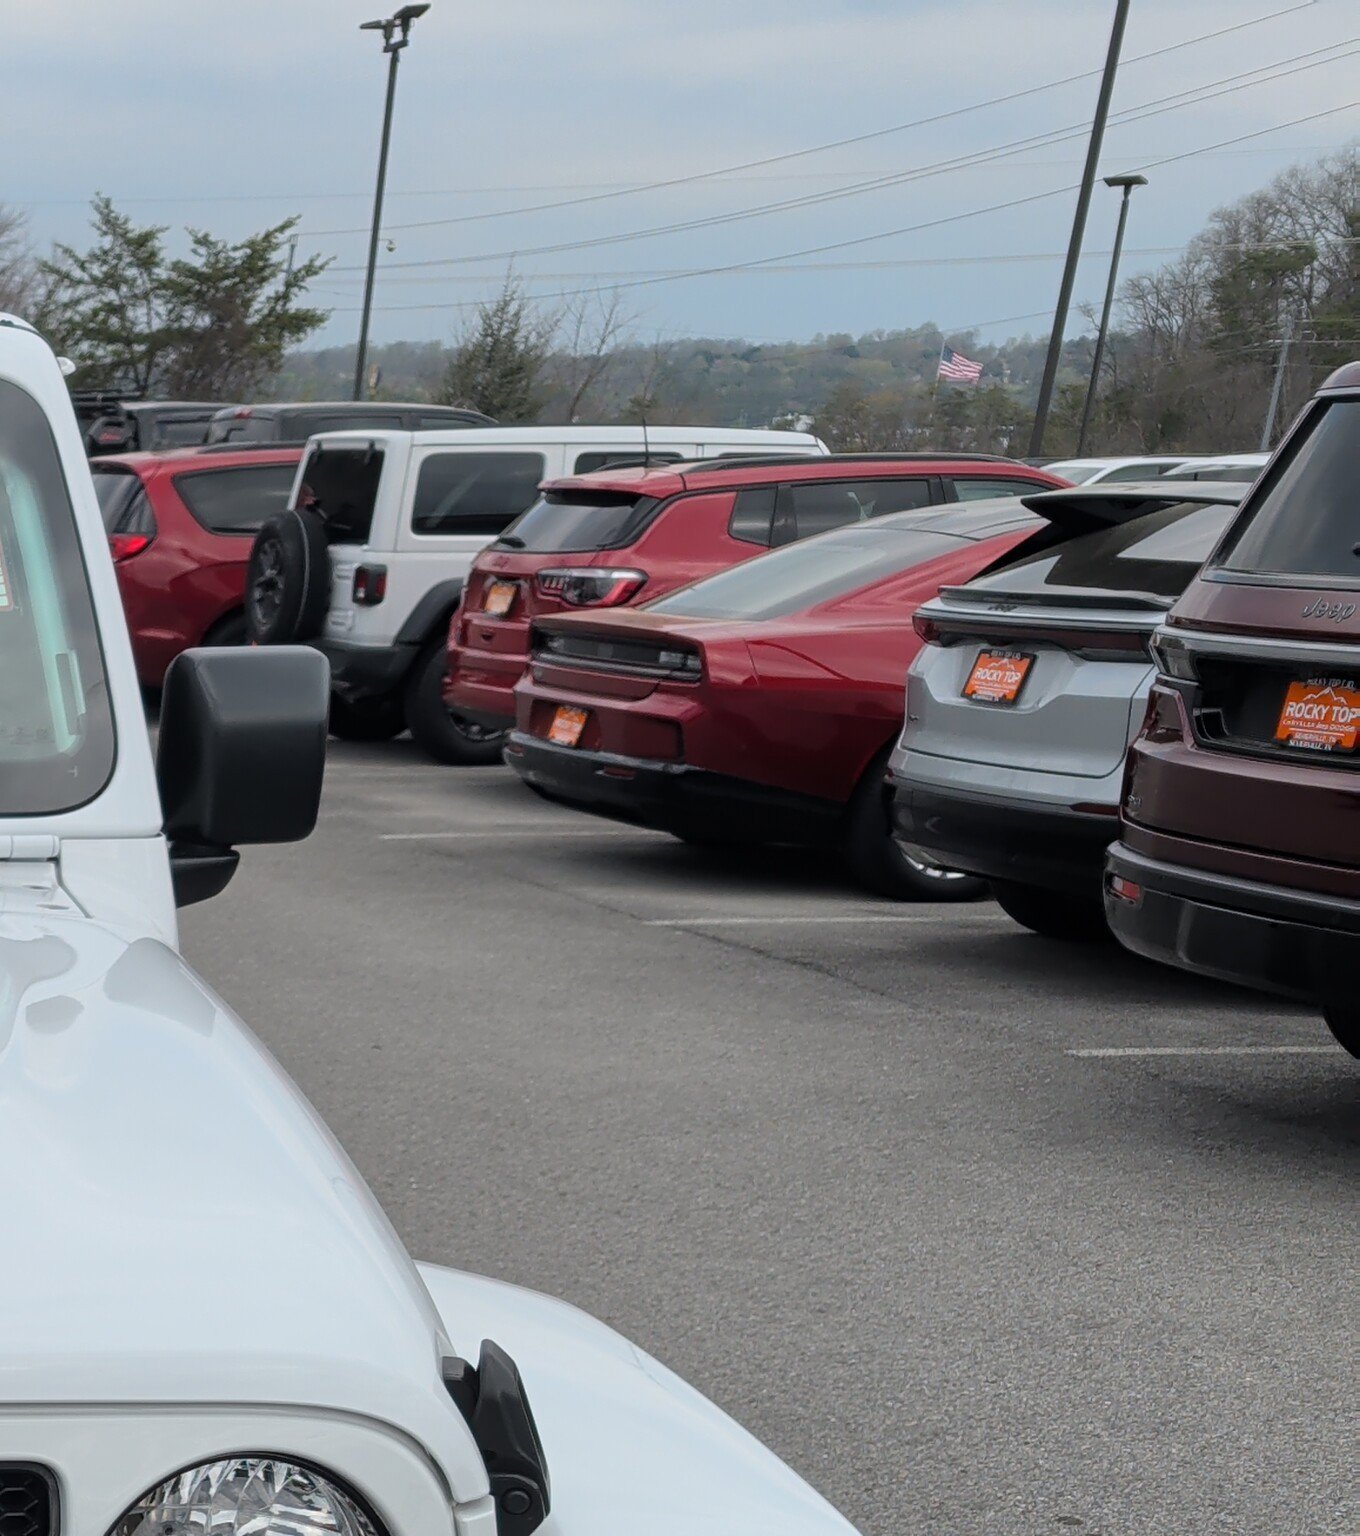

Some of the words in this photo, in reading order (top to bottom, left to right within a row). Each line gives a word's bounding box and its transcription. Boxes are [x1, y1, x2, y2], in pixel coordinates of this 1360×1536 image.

[1301, 597, 1357, 624] Jeep
[975, 668, 1002, 682] ROCKY
[1004, 671, 1022, 683] TOP
[1285, 701, 1331, 721] ROCKY
[1331, 705, 1360, 723] TOP
